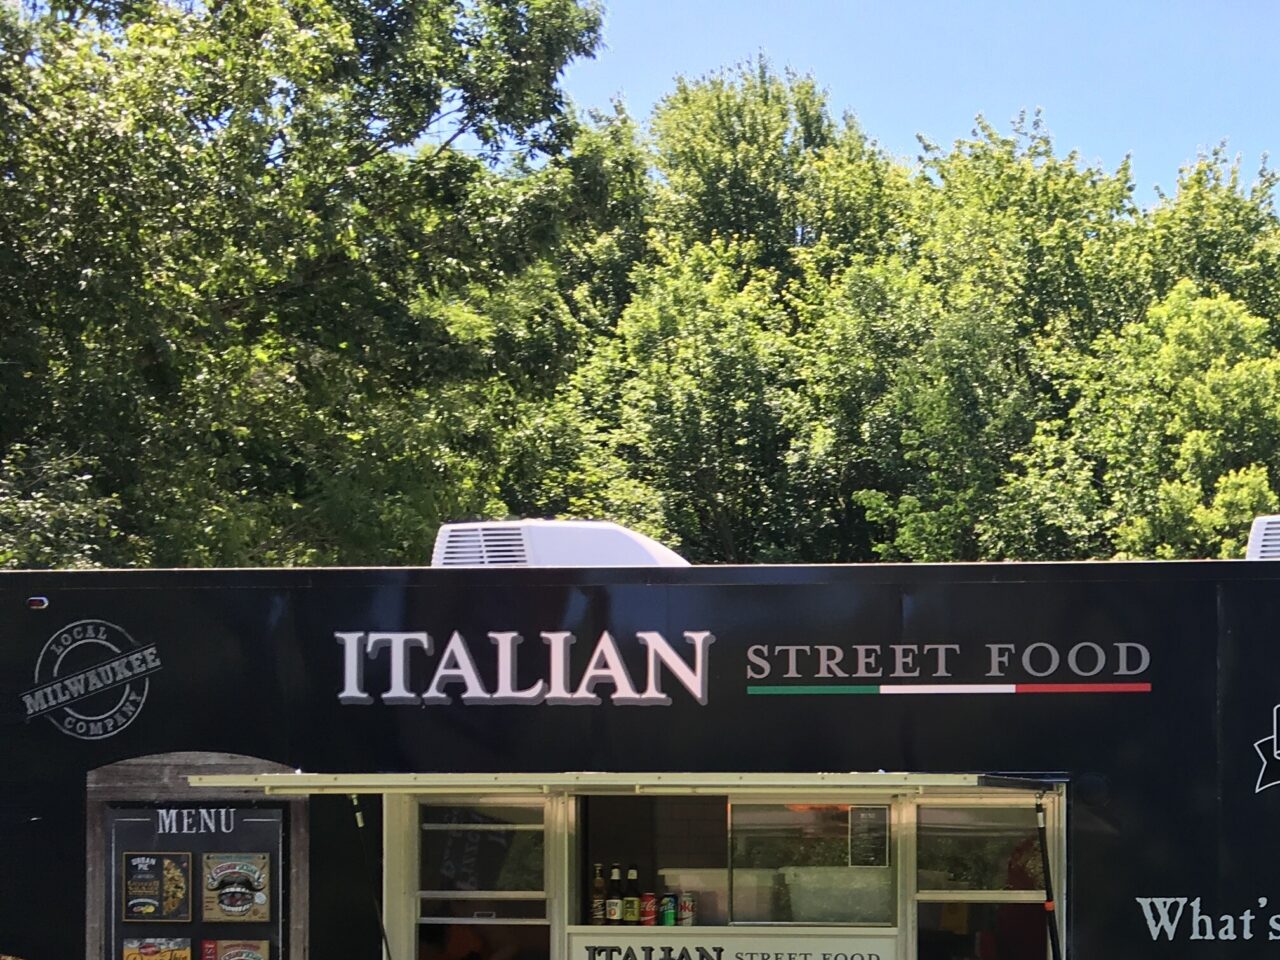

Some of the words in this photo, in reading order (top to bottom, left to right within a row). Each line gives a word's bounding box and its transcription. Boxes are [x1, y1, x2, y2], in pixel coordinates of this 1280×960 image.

[51, 626, 108, 655] LOCAL
[746, 643, 960, 679] STREET
[985, 641, 1152, 677] FOOD
[22, 648, 162, 715] MILWAUKEE
[335, 630, 715, 705] ITALIAN
[64, 691, 142, 735] COMPANY
[157, 808, 237, 834] MENU
